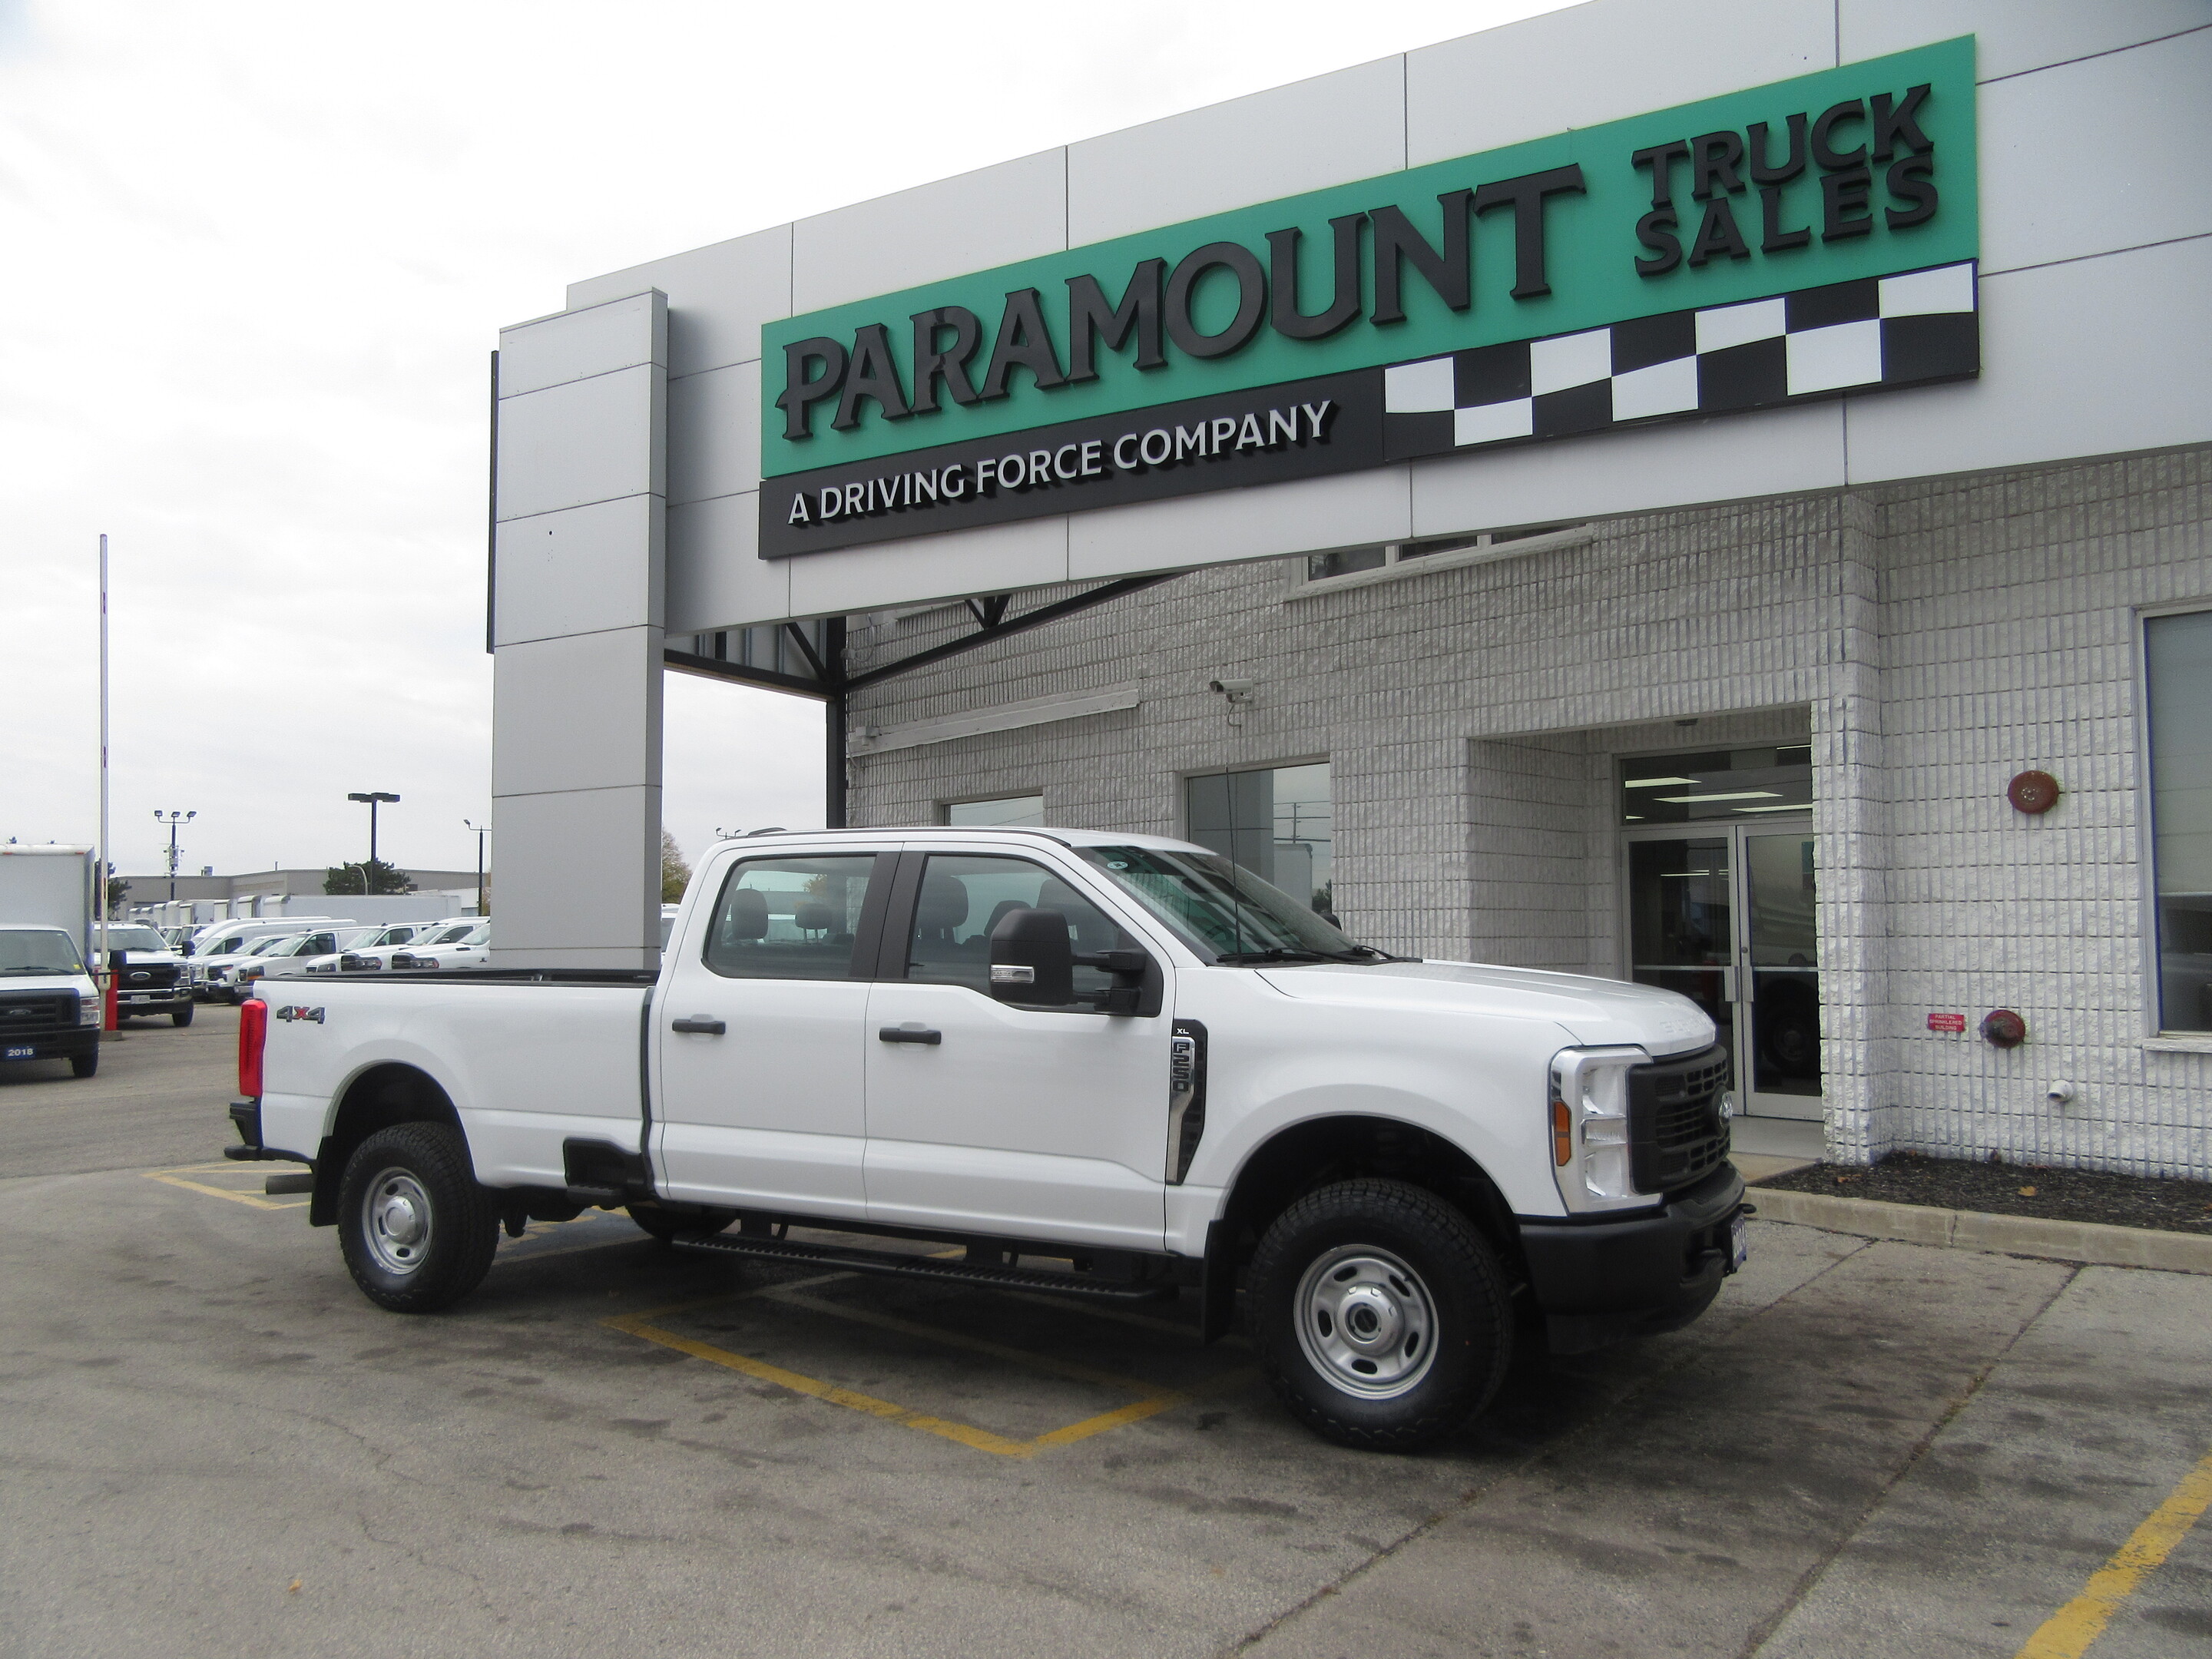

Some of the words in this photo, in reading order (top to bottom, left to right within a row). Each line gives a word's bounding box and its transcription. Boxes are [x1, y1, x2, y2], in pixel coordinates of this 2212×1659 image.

[1631, 83, 1934, 209] TRUCK
[1634, 155, 1939, 277] SALES
[775, 163, 1587, 441] PARAMOUNT
[787, 493, 810, 524] A
[820, 464, 964, 519] DRIVING
[976, 440, 1102, 493] FORCE
[1113, 400, 1333, 470] COMPANY
[1173, 1042, 1190, 1091] F250
